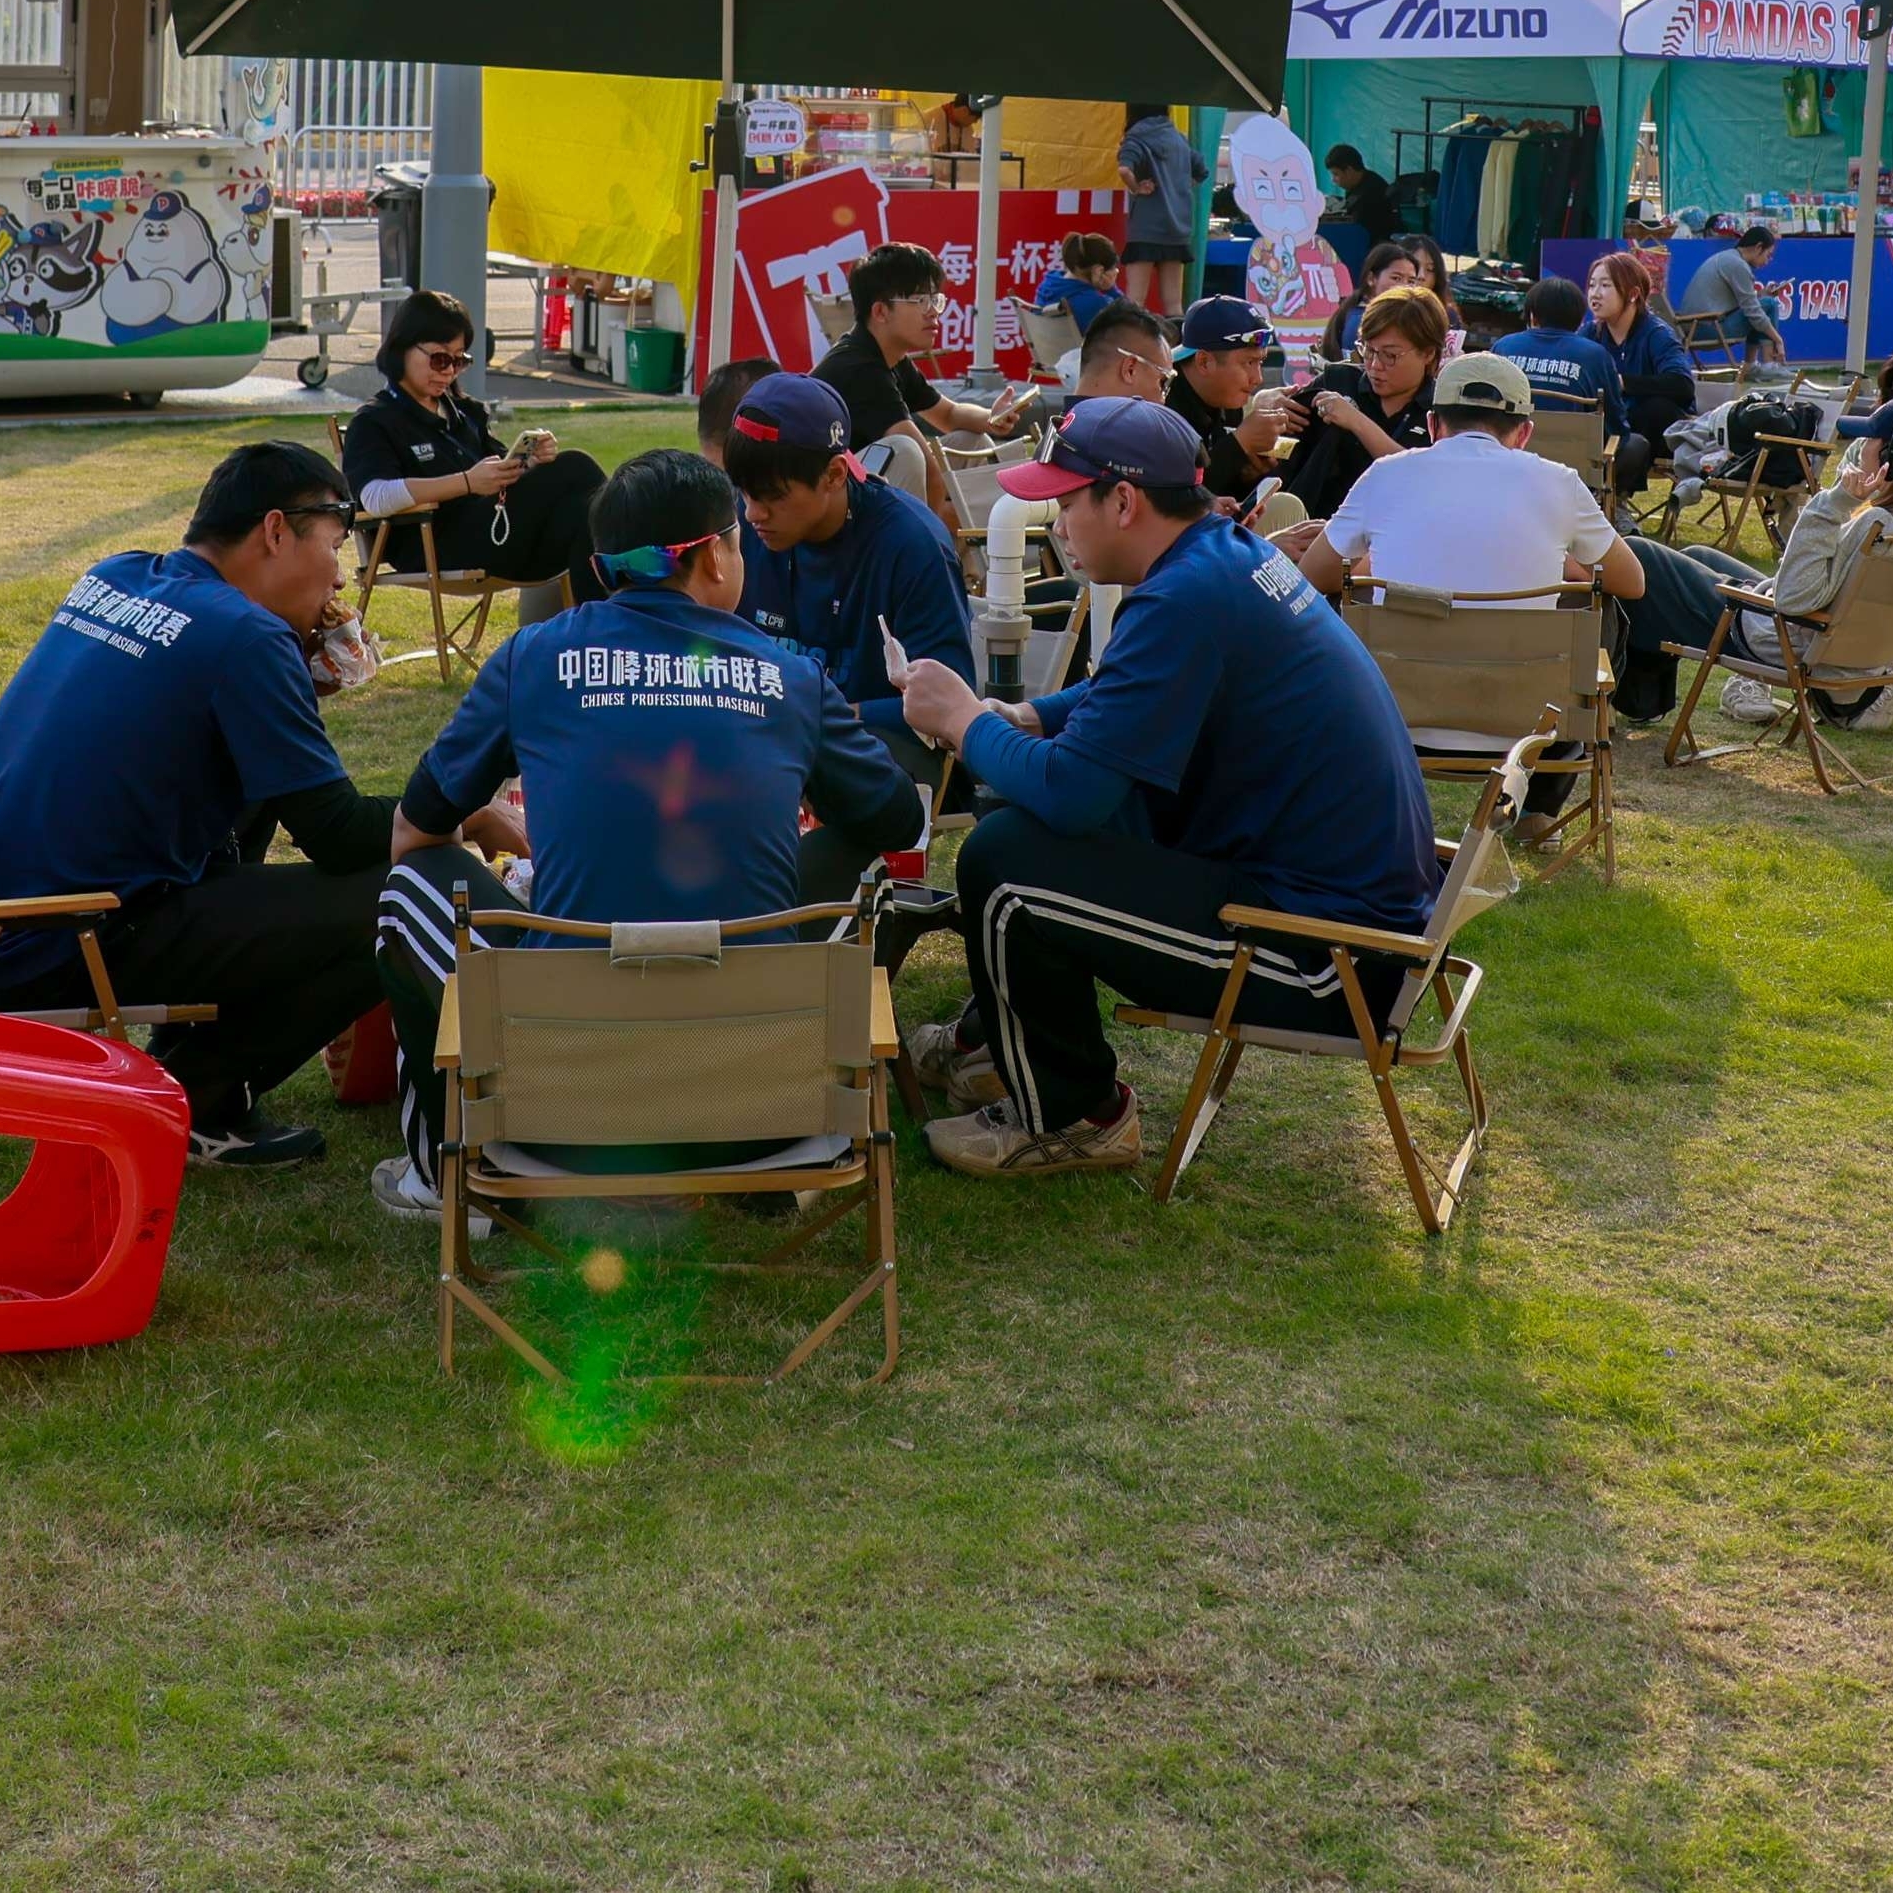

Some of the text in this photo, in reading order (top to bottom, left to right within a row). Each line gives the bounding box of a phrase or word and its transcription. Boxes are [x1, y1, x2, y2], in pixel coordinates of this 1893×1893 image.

[45, 193, 78, 210] 都是
[1799, 280, 1849, 320] 1941
[768, 614, 786, 628] CPB
[107, 632, 147, 659] BASEBALL
[558, 646, 785, 701] 中国棒球城市联赛
[581, 692, 767, 718] CHINESE PROFESSIONAL BASEBALL
